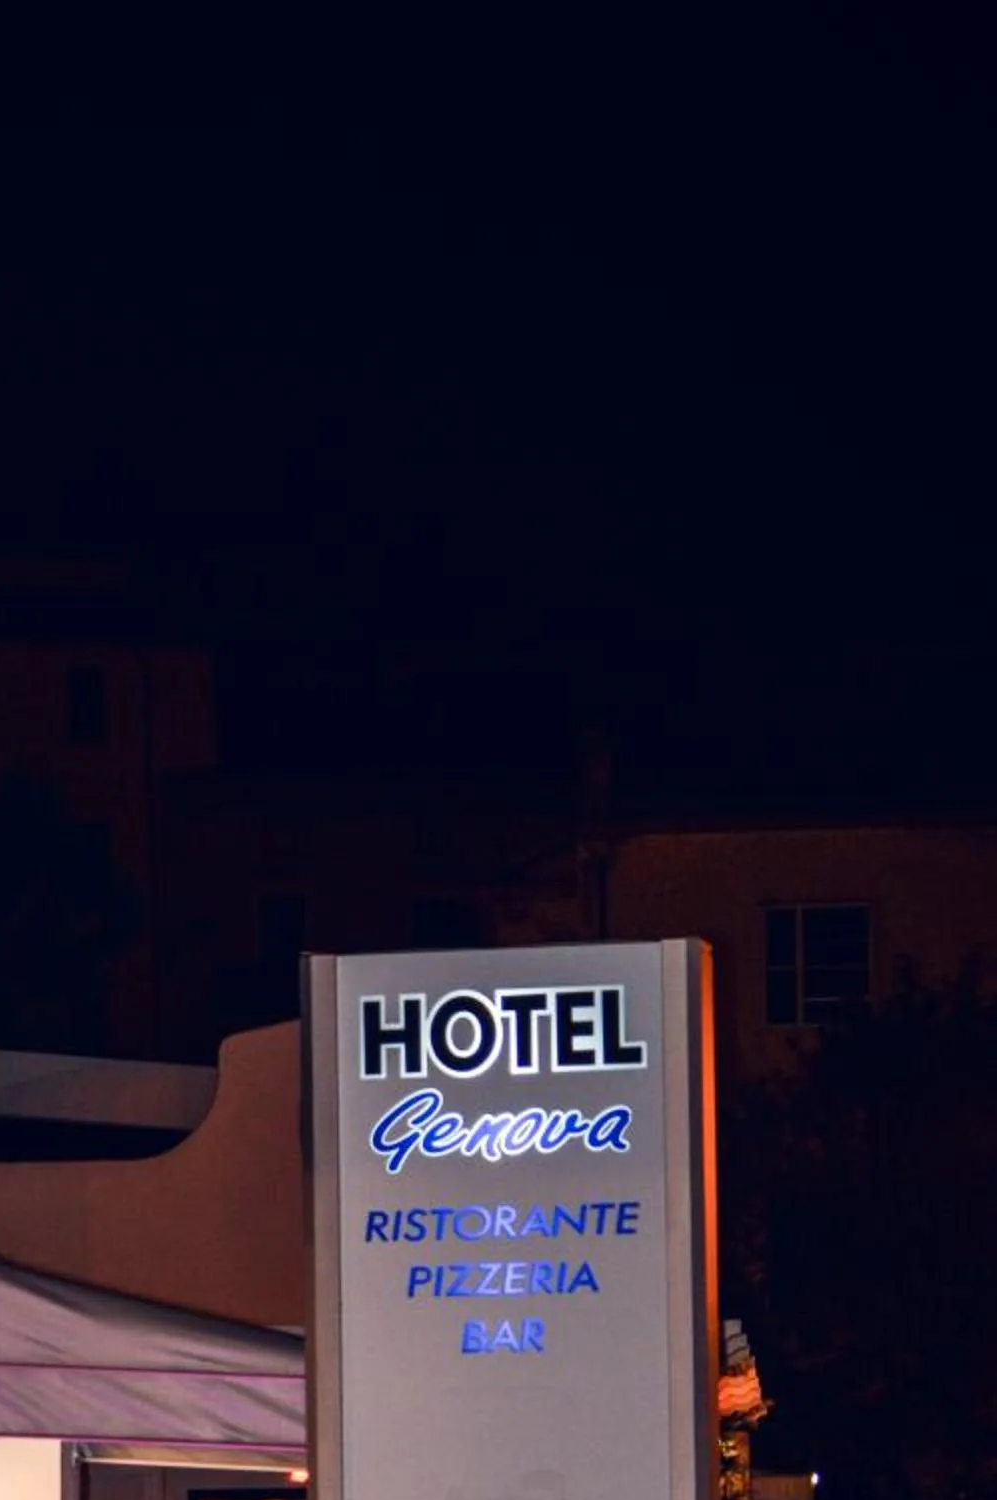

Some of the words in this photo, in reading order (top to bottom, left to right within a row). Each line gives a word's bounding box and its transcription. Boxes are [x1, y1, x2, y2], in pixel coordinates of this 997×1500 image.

[360, 984, 648, 1080] HOTEL
[370, 1088, 633, 1174] Genova
[365, 1202, 641, 1243] RISTORANTE
[408, 1261, 600, 1298] PIZZERIA
[461, 1318, 546, 1355] BAR
